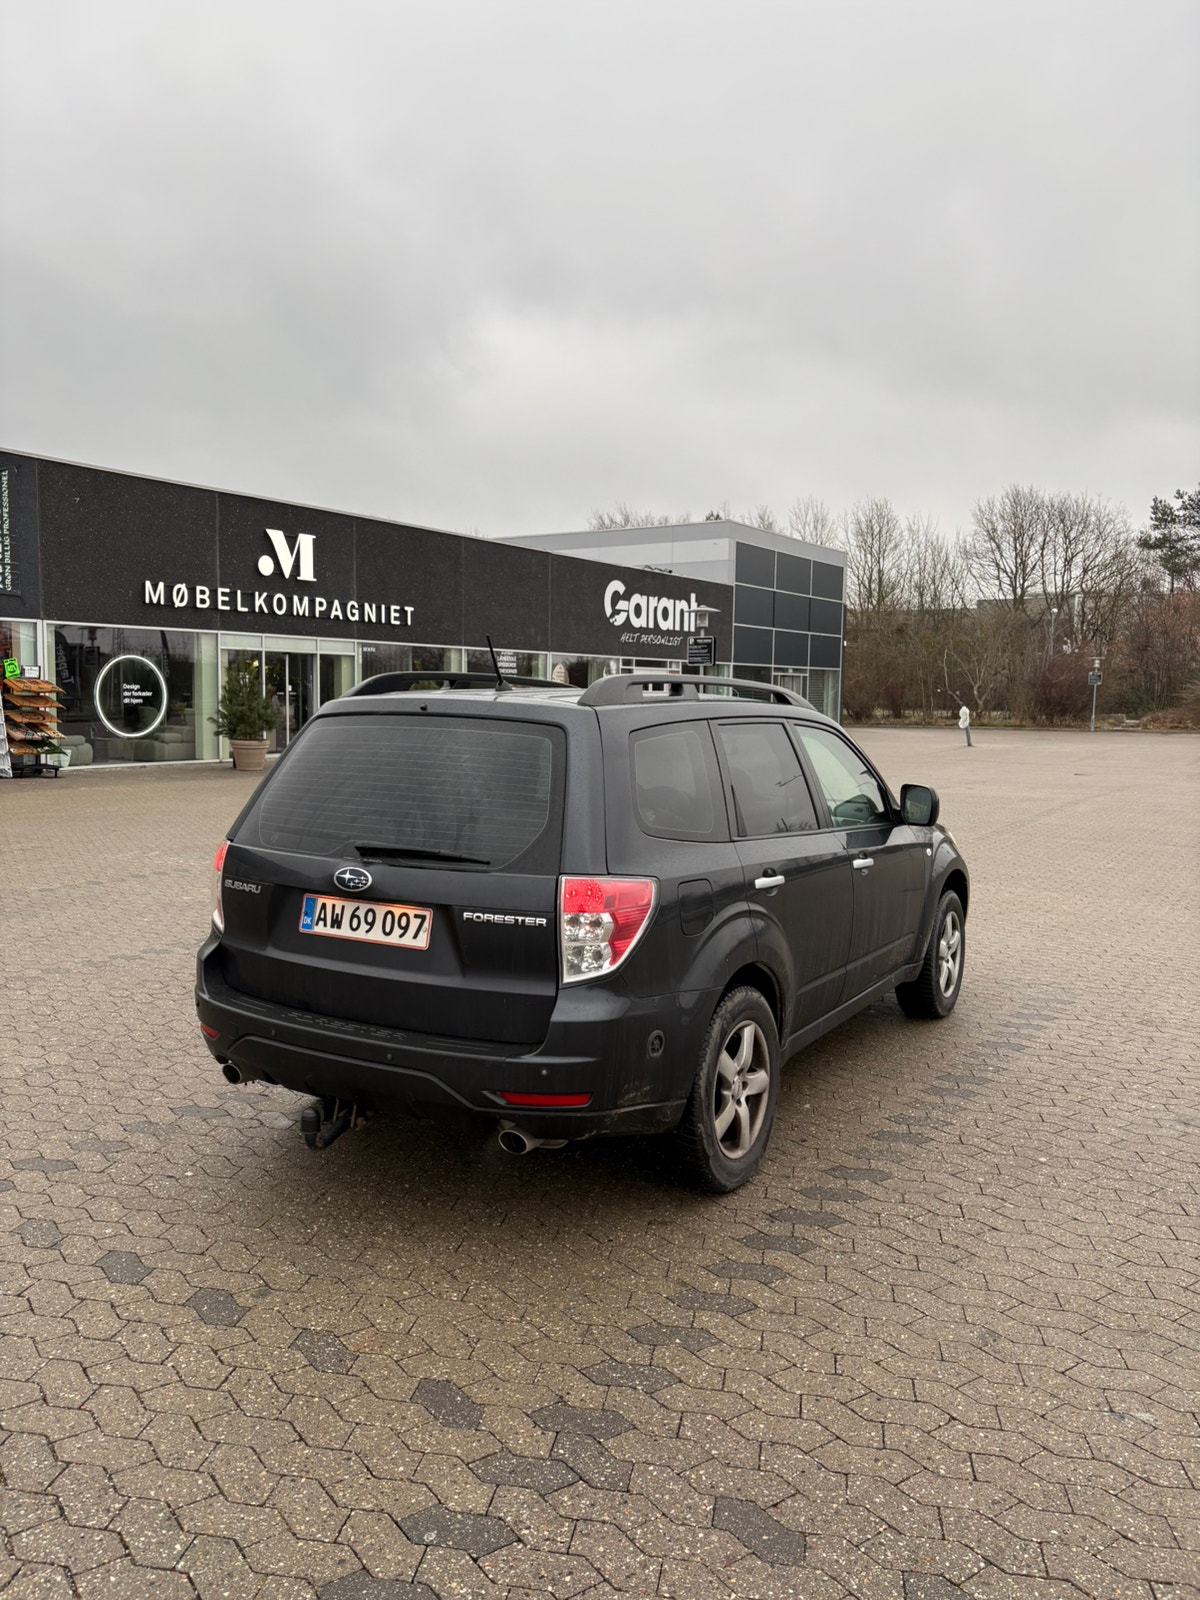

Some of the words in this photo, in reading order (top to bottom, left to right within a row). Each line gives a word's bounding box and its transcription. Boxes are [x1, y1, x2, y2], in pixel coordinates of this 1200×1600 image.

[144, 580, 415, 626] MØBELKOMPAGNIET
[604, 580, 698, 632] Garant
[620, 632, 640, 643] HELT
[640, 634, 683, 646] PERSONLIGT
[224, 878, 262, 895] SUBARU
[303, 916, 312, 925] DK
[315, 902, 345, 930] AW
[349, 906, 377, 934] 69
[382, 909, 427, 940] 097
[463, 911, 547, 928] FORESTER
